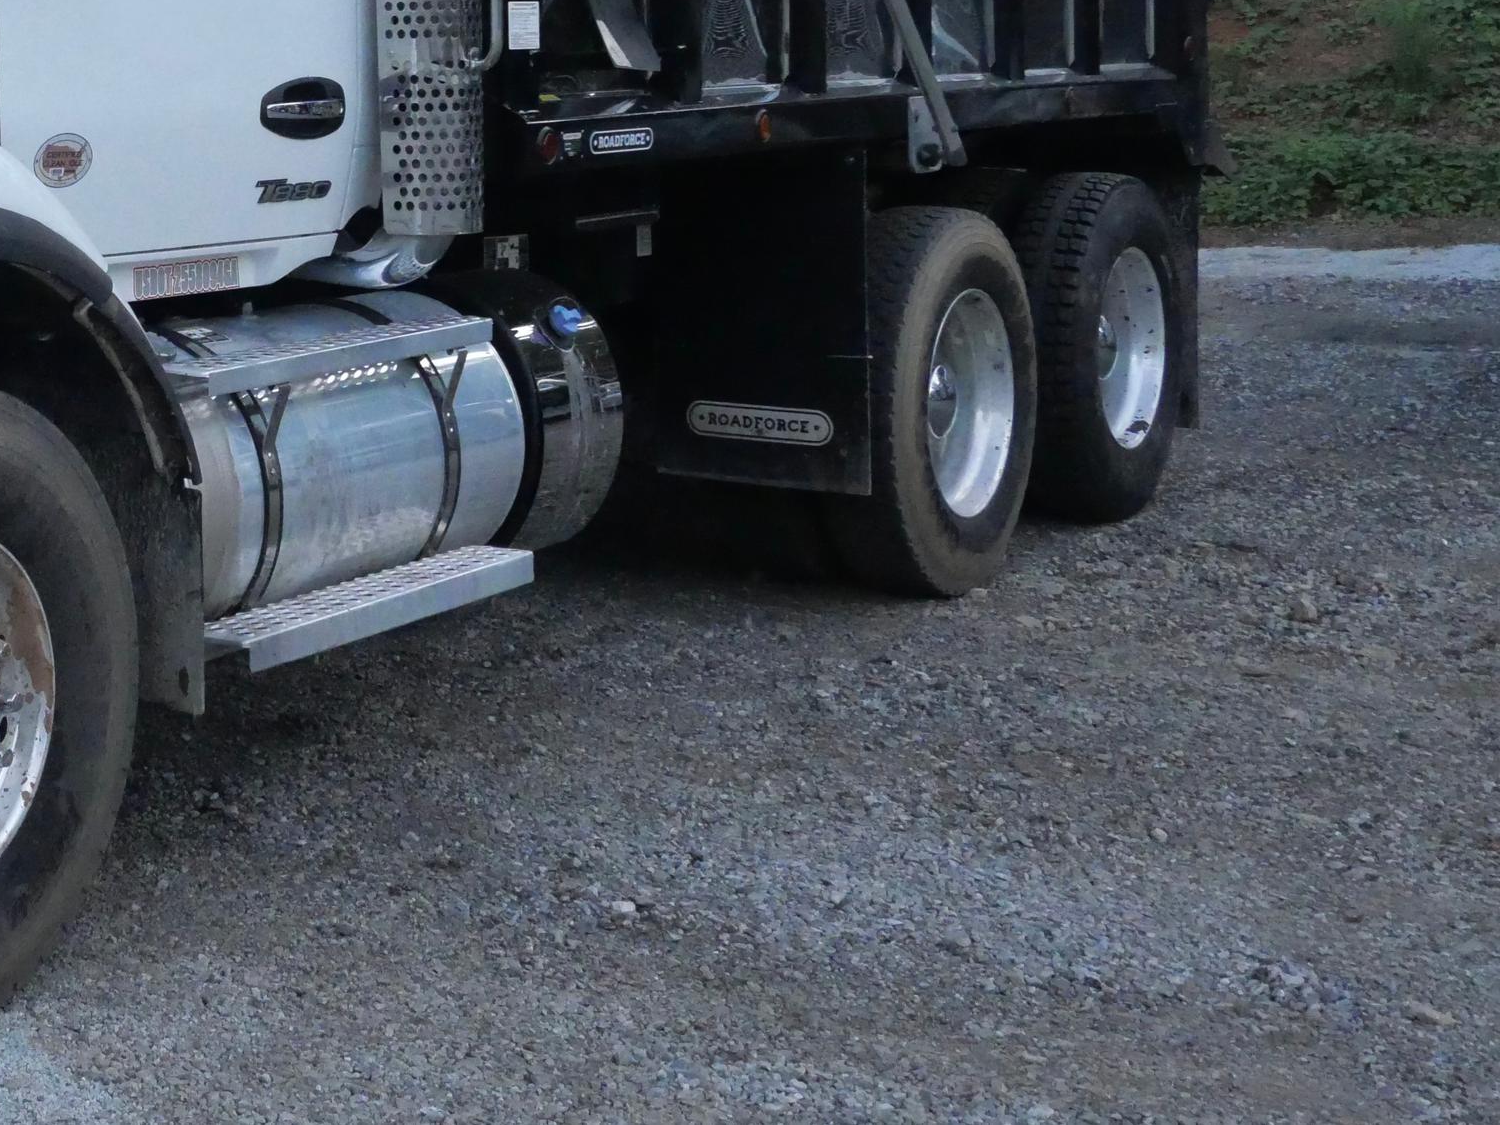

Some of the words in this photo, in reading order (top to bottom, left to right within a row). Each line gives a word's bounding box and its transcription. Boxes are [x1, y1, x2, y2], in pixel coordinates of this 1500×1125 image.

[597, 132, 646, 149] ROADFORCE
[255, 178, 332, 204] T880
[133, 264, 173, 301] USDOT
[707, 411, 810, 434] ROADFORCE
